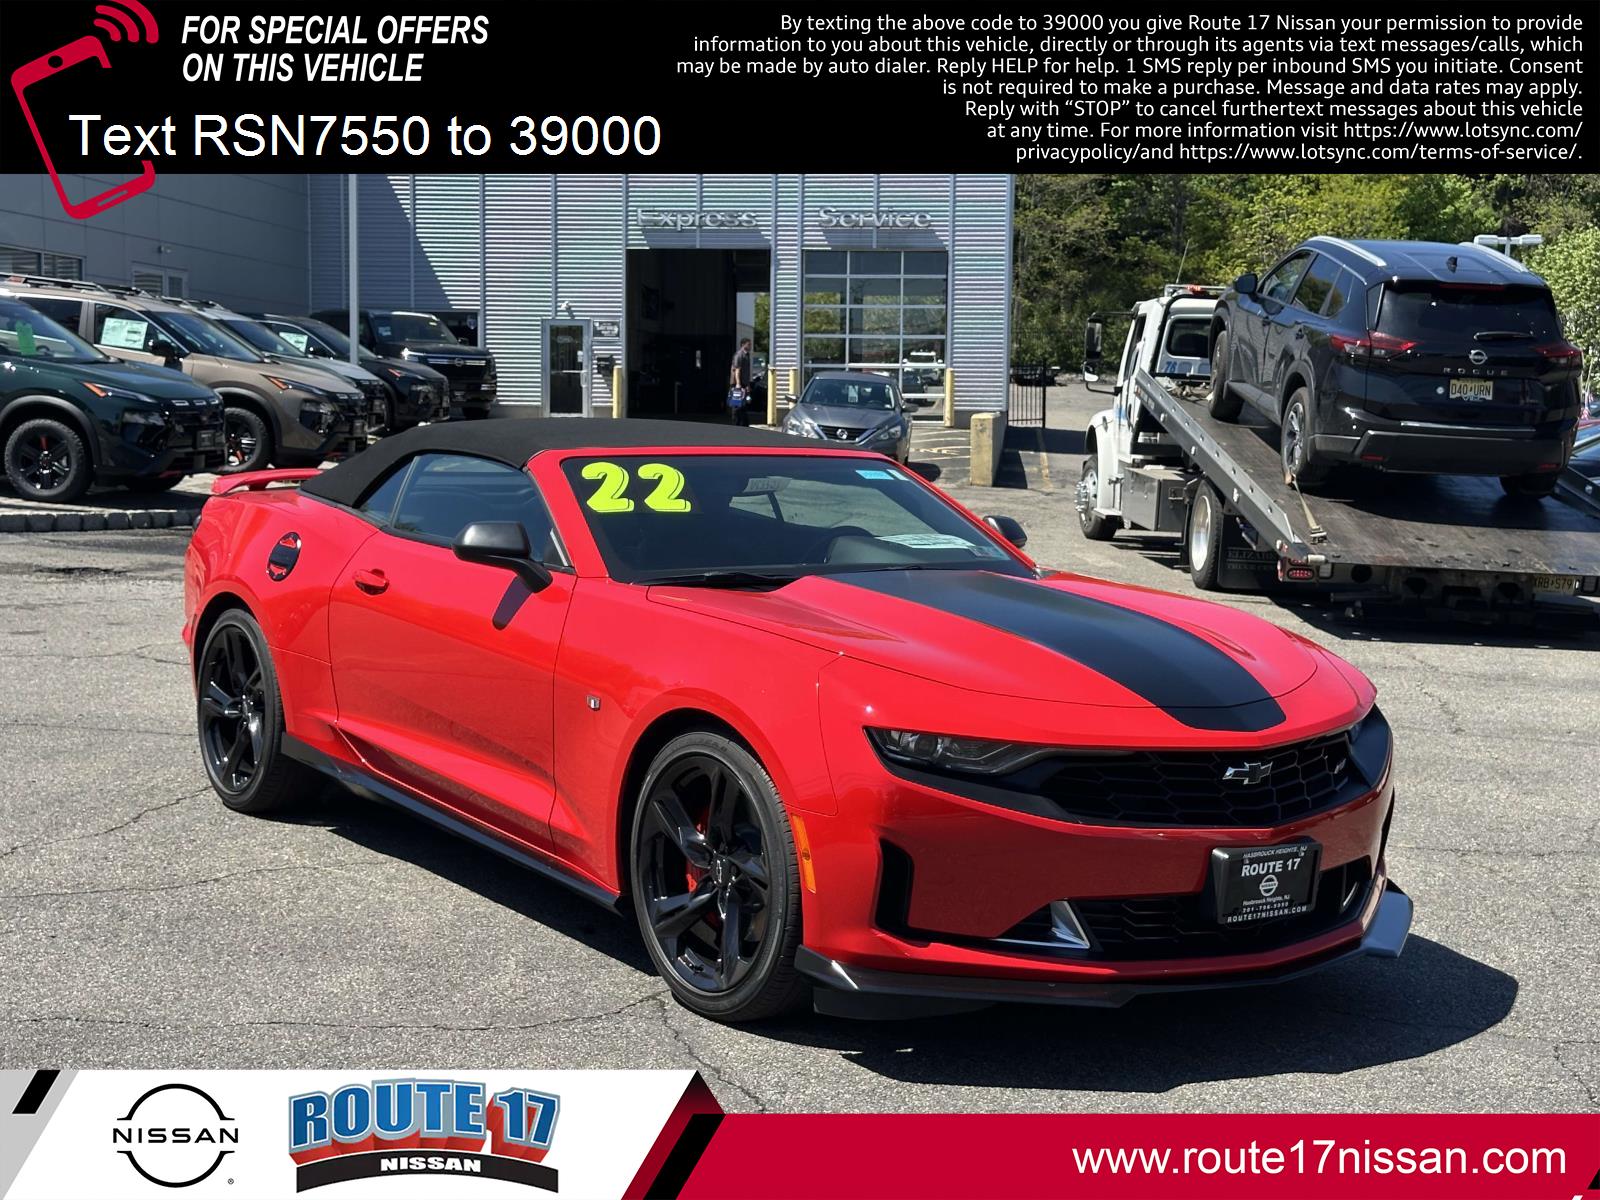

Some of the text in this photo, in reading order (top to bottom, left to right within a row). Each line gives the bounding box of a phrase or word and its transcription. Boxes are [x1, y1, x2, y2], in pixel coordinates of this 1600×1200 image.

[637, 206, 932, 231] Express Service
[1443, 367, 1508, 376] ROGUE
[581, 461, 692, 512] 22
[1241, 858, 1302, 877] ROUTE 17
[1227, 905, 1308, 923] ROUTE17NISSAN.COM
